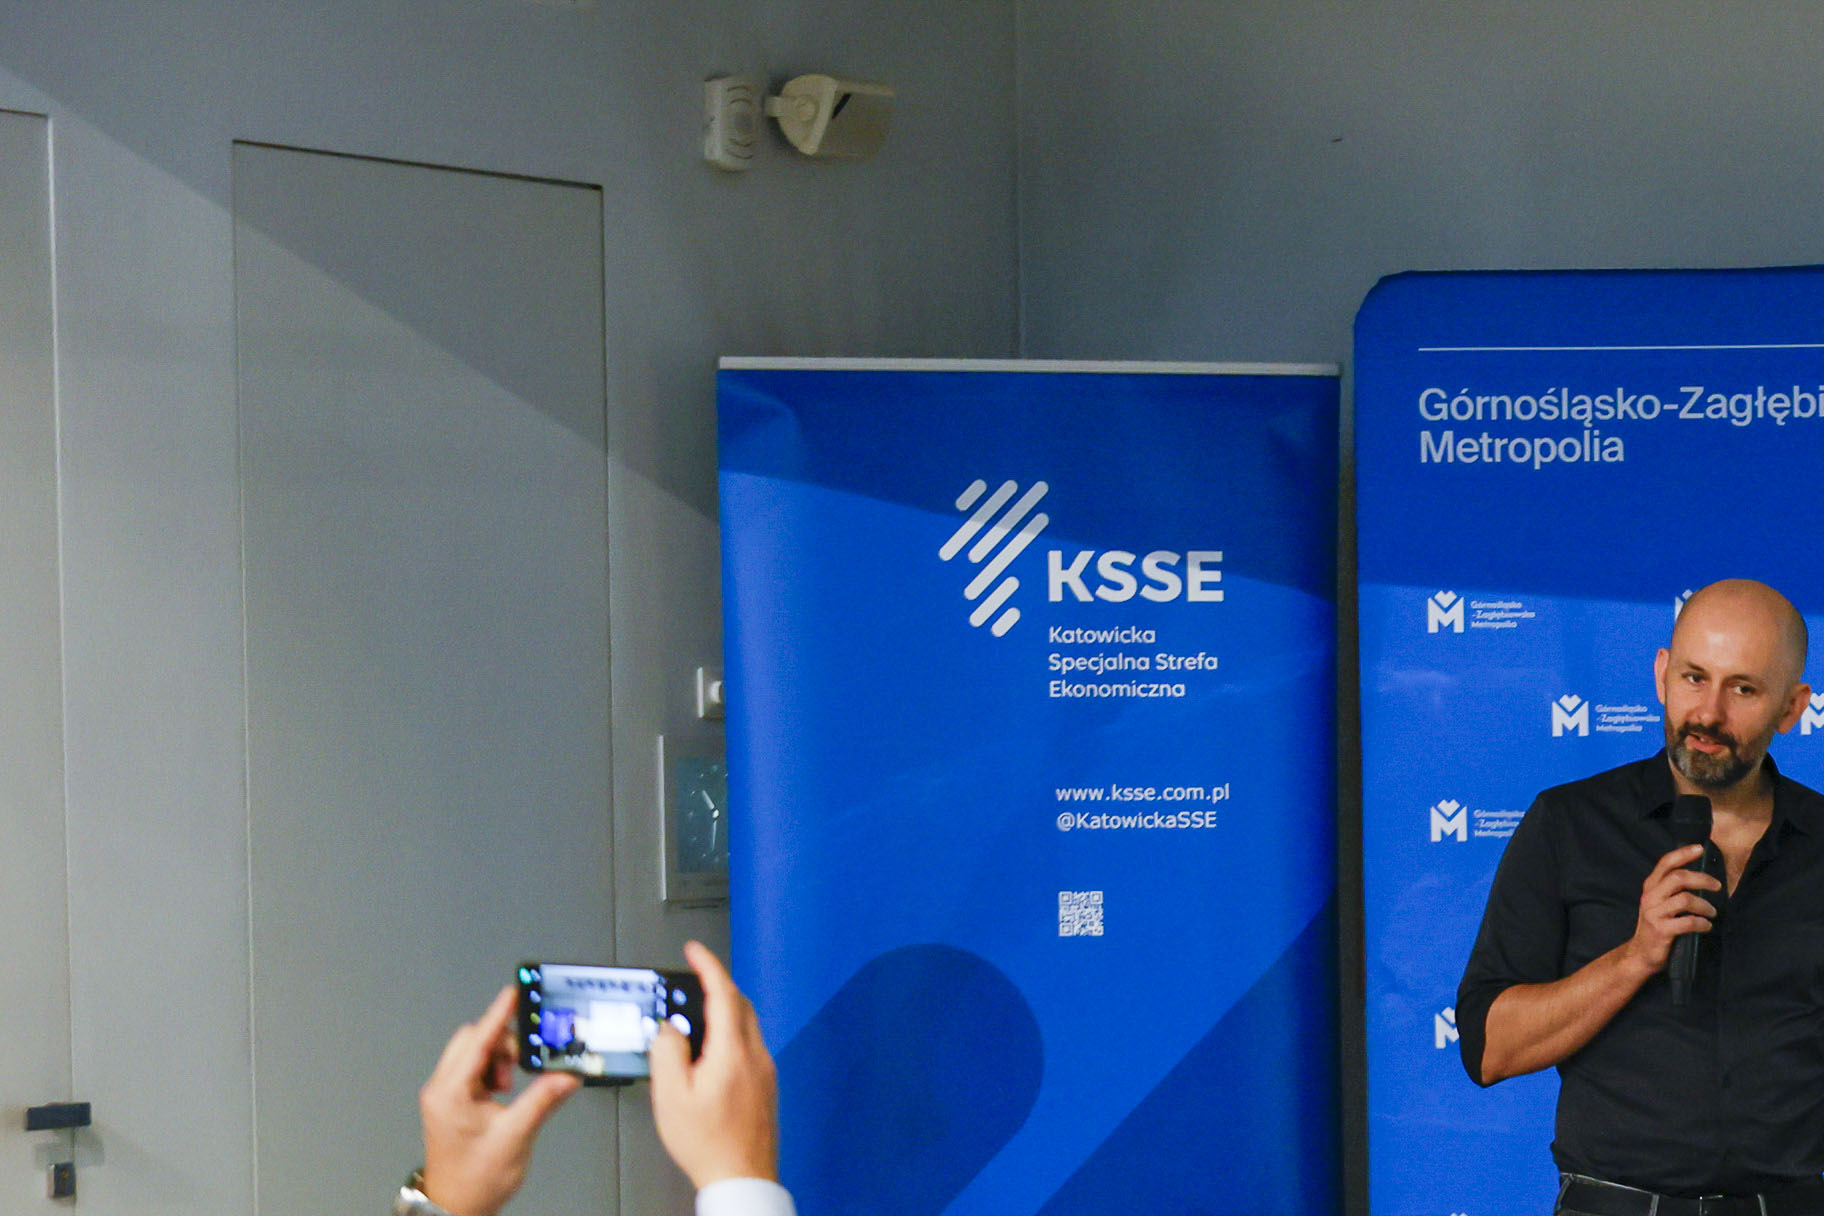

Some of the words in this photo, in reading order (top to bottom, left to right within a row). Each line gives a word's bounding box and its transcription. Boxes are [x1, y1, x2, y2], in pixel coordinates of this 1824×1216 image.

[1420, 429, 1625, 470] Metropolia
[1048, 550, 1225, 602] KSSE
[1049, 625, 1156, 643] Katowicka
[1049, 652, 1150, 673] Specjalna
[1156, 651, 1218, 670] Strefa
[1049, 679, 1186, 698] Ekonomiczna
[1055, 782, 1230, 804] www.ksse.com.pl
[1056, 810, 1217, 831] @KatowickaSSE
